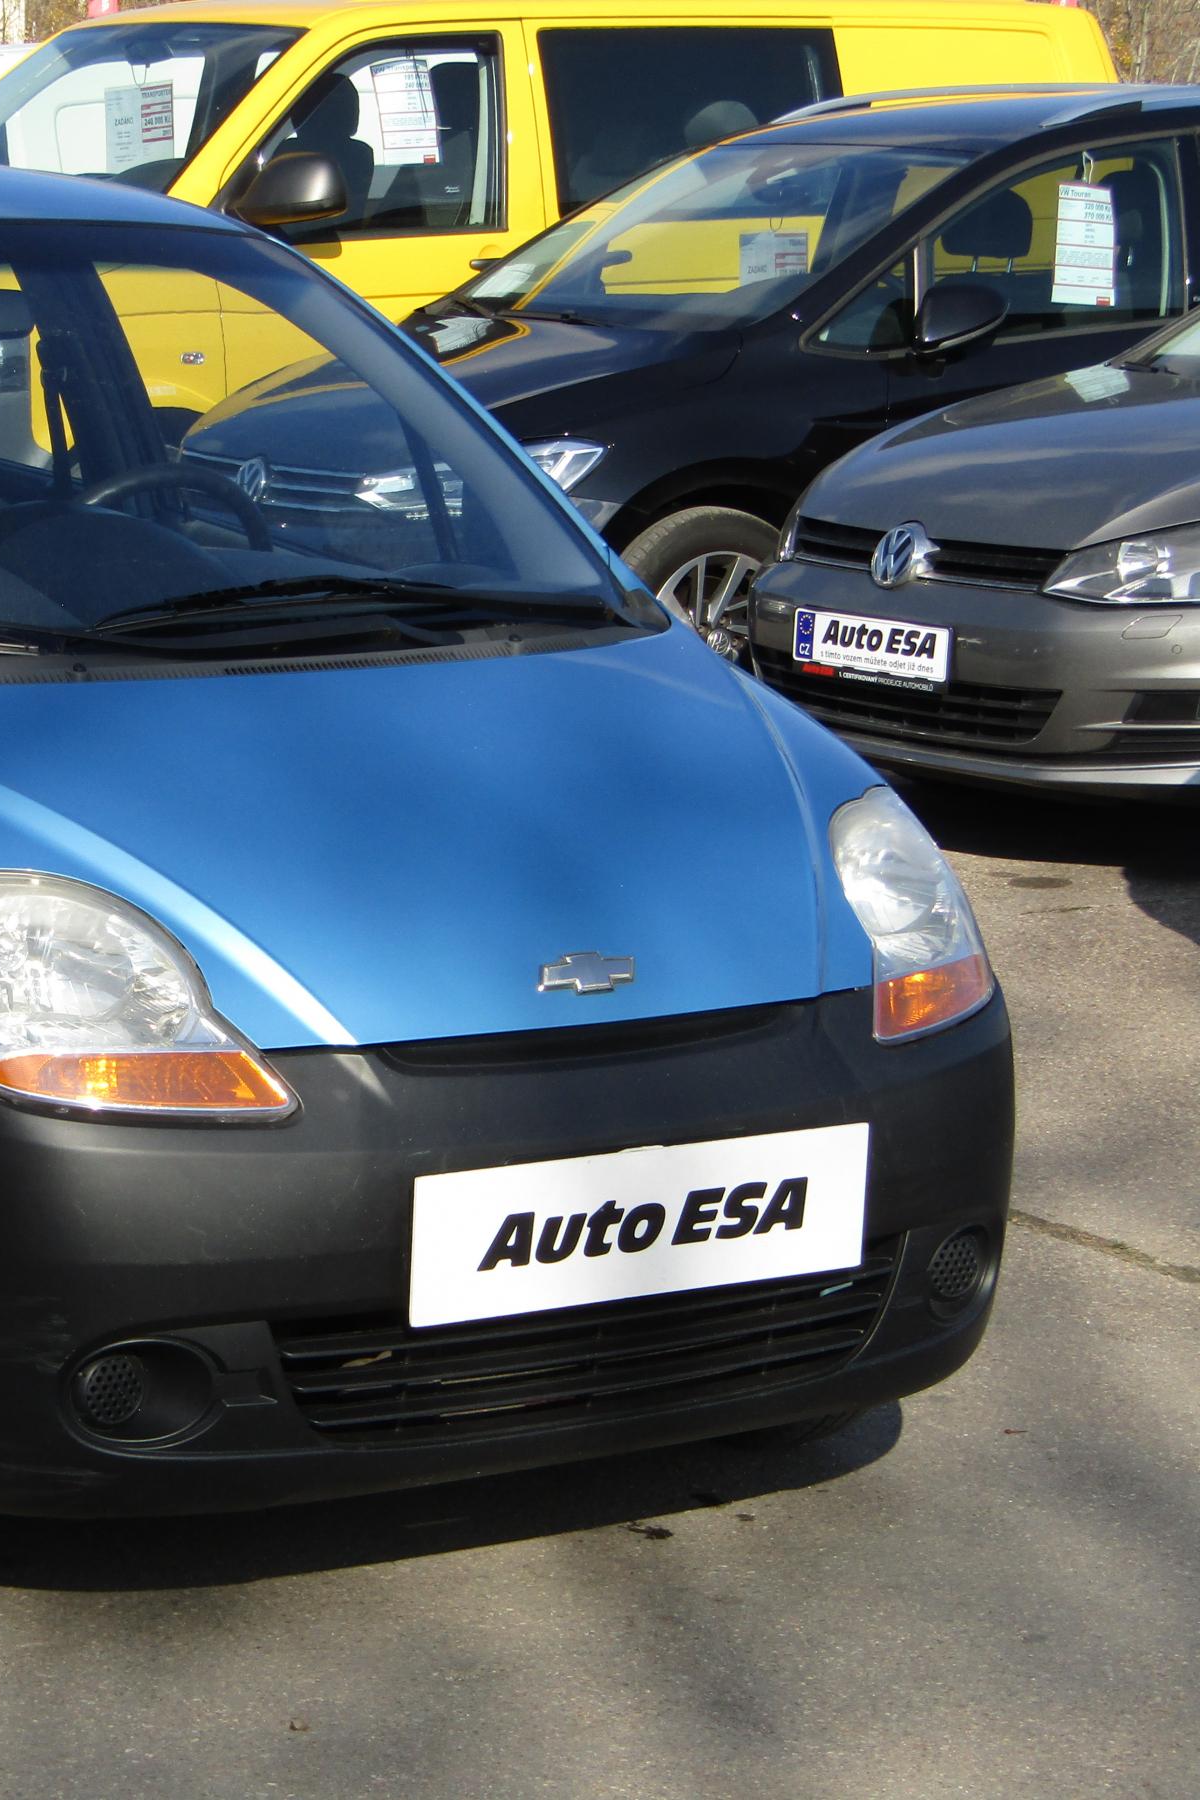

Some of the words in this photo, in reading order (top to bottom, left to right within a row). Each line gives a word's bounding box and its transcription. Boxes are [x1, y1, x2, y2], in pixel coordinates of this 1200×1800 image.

[799, 643, 810, 656] CZ
[821, 619, 883, 652] Auto
[885, 628, 937, 659] ESA
[843, 653, 862, 663] vozem
[889, 660, 906, 670] odjet
[917, 664, 934, 673] dnes
[476, 1200, 666, 1272] Auto
[671, 1176, 809, 1246] ESA
